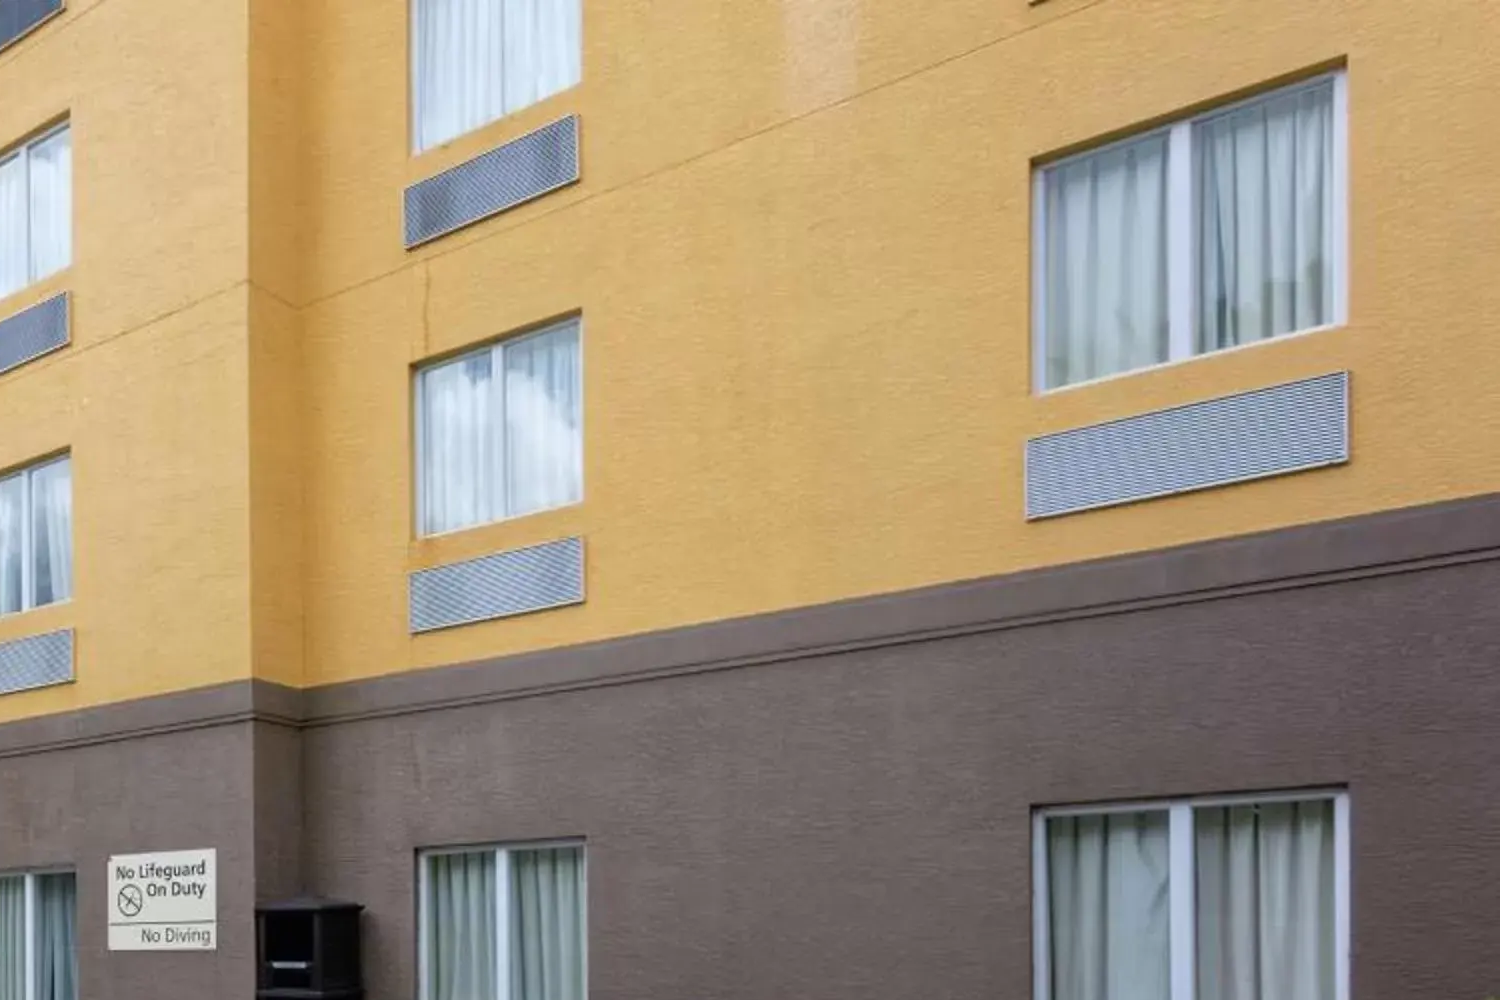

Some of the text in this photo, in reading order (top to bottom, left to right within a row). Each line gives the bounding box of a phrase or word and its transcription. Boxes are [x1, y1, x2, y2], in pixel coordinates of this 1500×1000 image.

[116, 859, 206, 881] No Lifeguard
[146, 881, 206, 899] On Duty
[141, 927, 211, 946] No Diving
